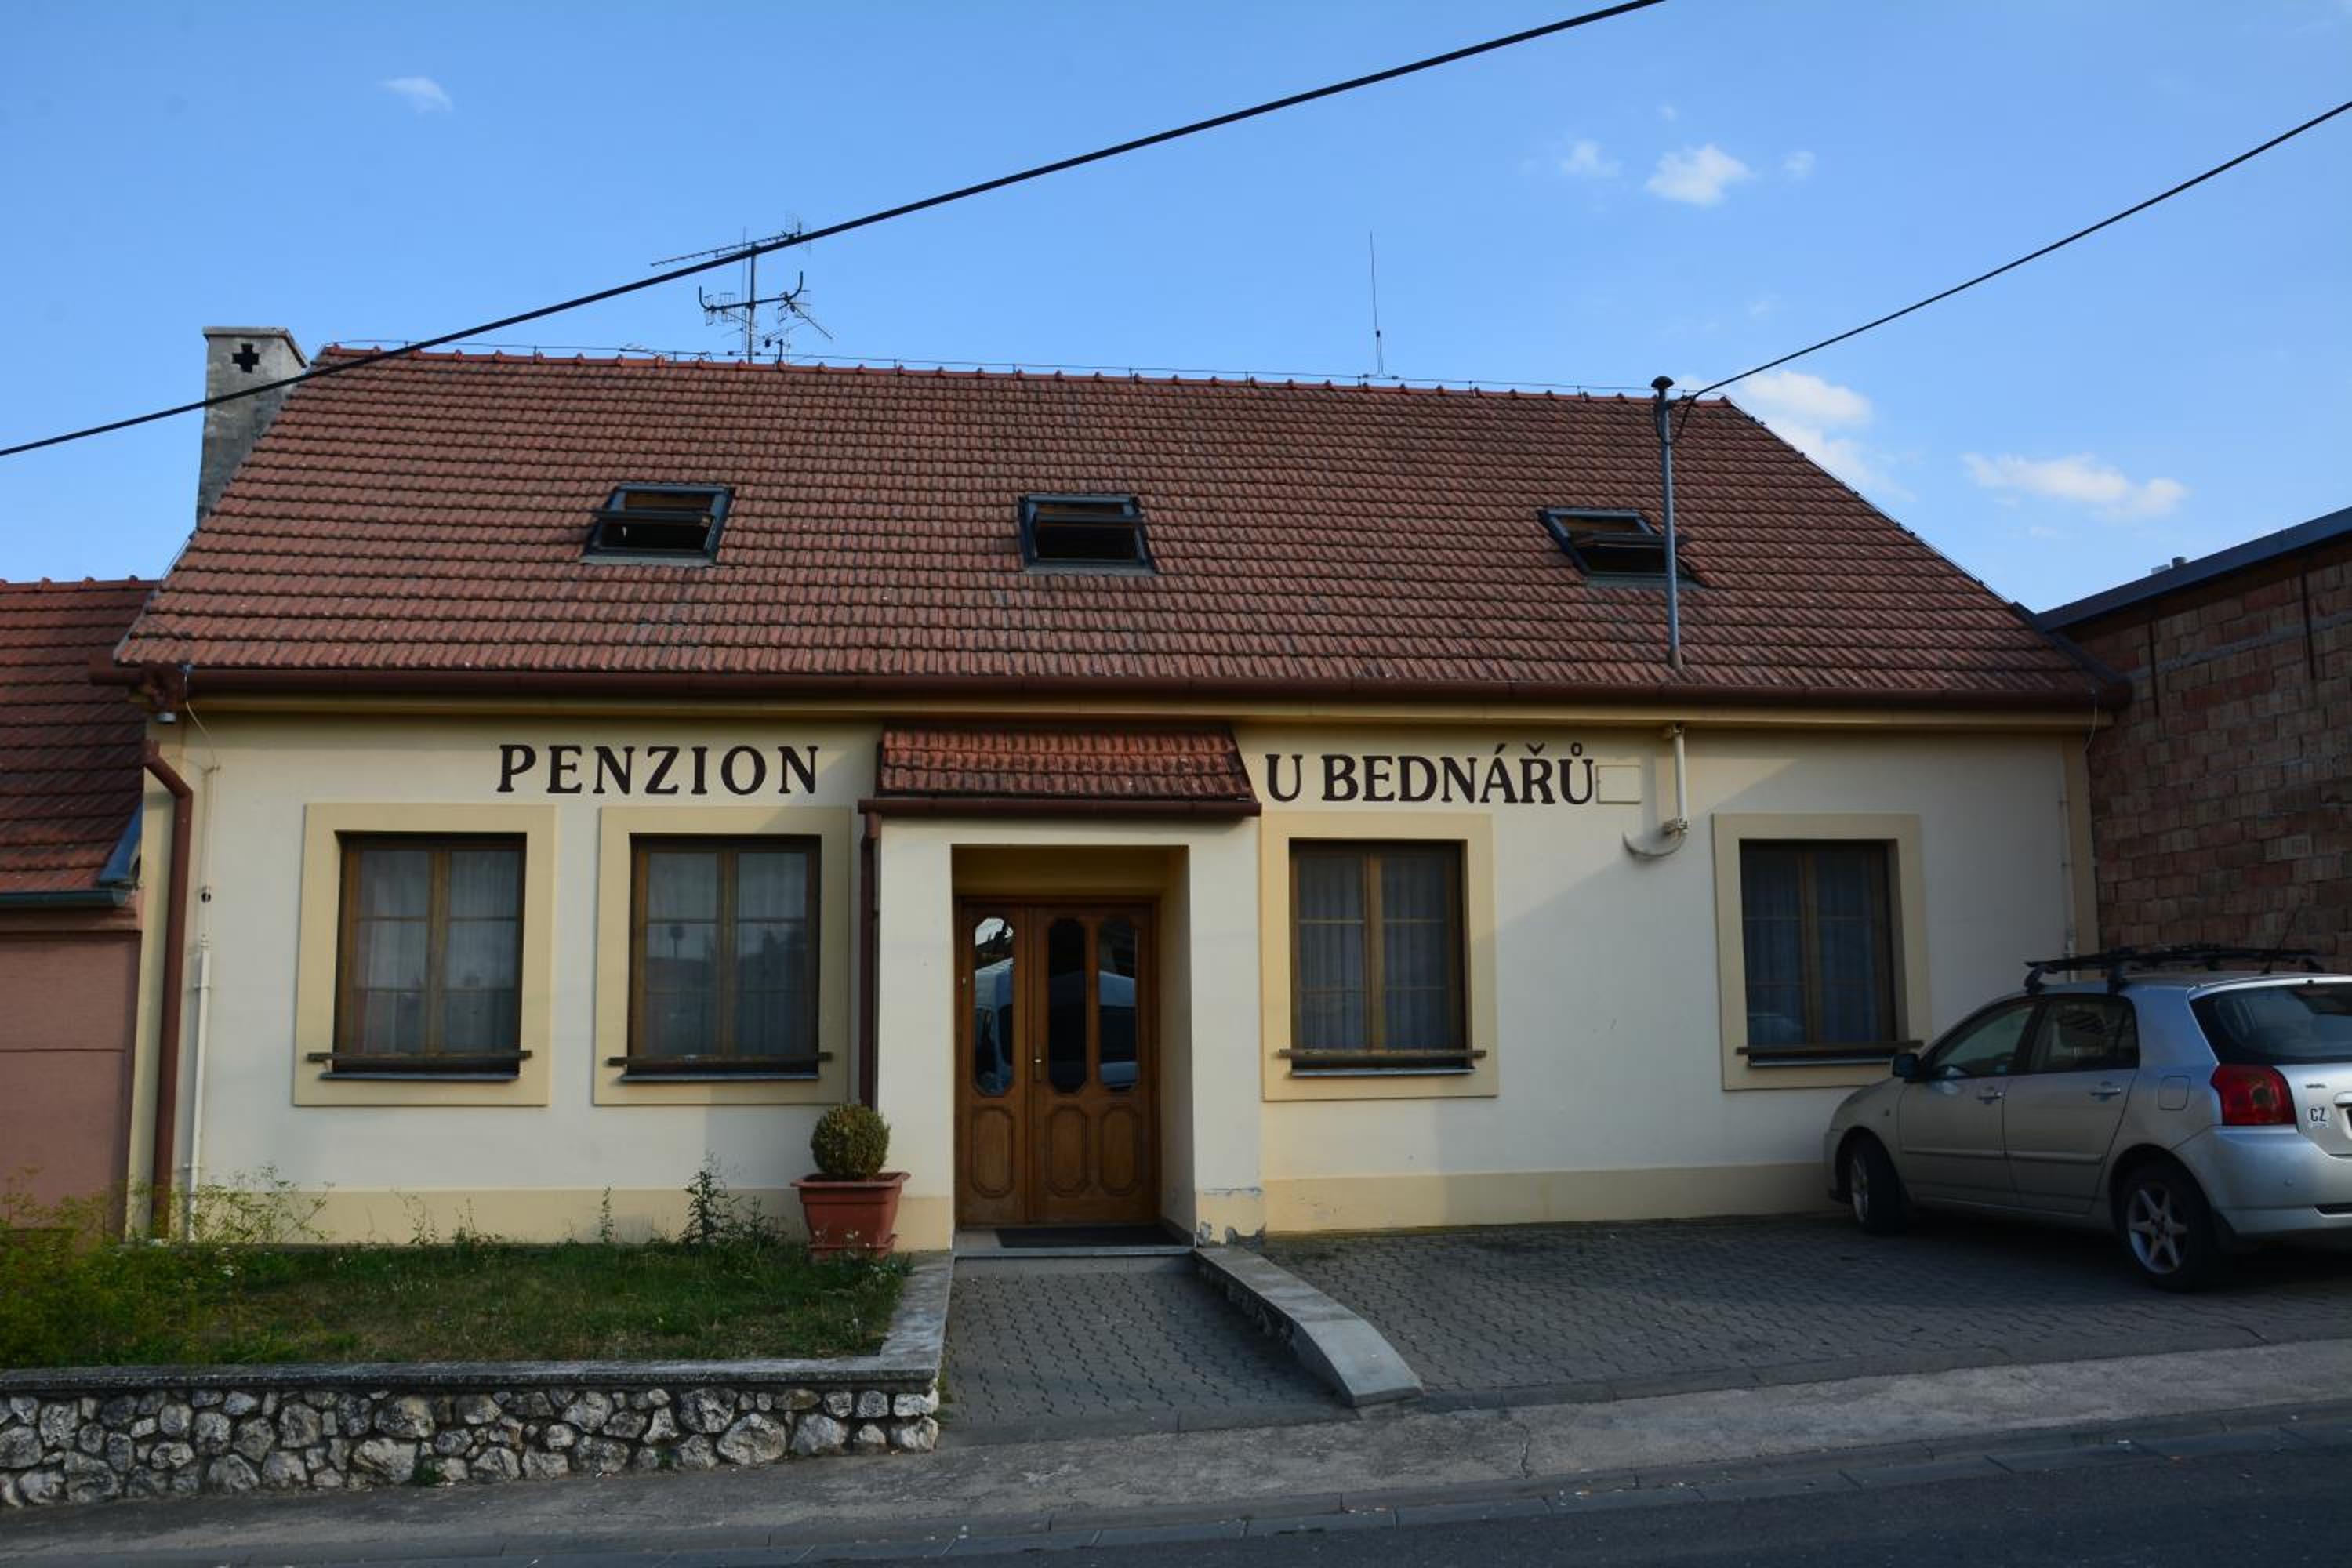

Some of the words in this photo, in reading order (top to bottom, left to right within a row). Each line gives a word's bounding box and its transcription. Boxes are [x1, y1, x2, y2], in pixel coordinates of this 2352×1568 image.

[496, 744, 818, 795] PENZION
[1265, 753, 1303, 802] U
[1321, 742, 1594, 804] BEDNÁŘŮ
[2310, 1107, 2327, 1121] CZ
